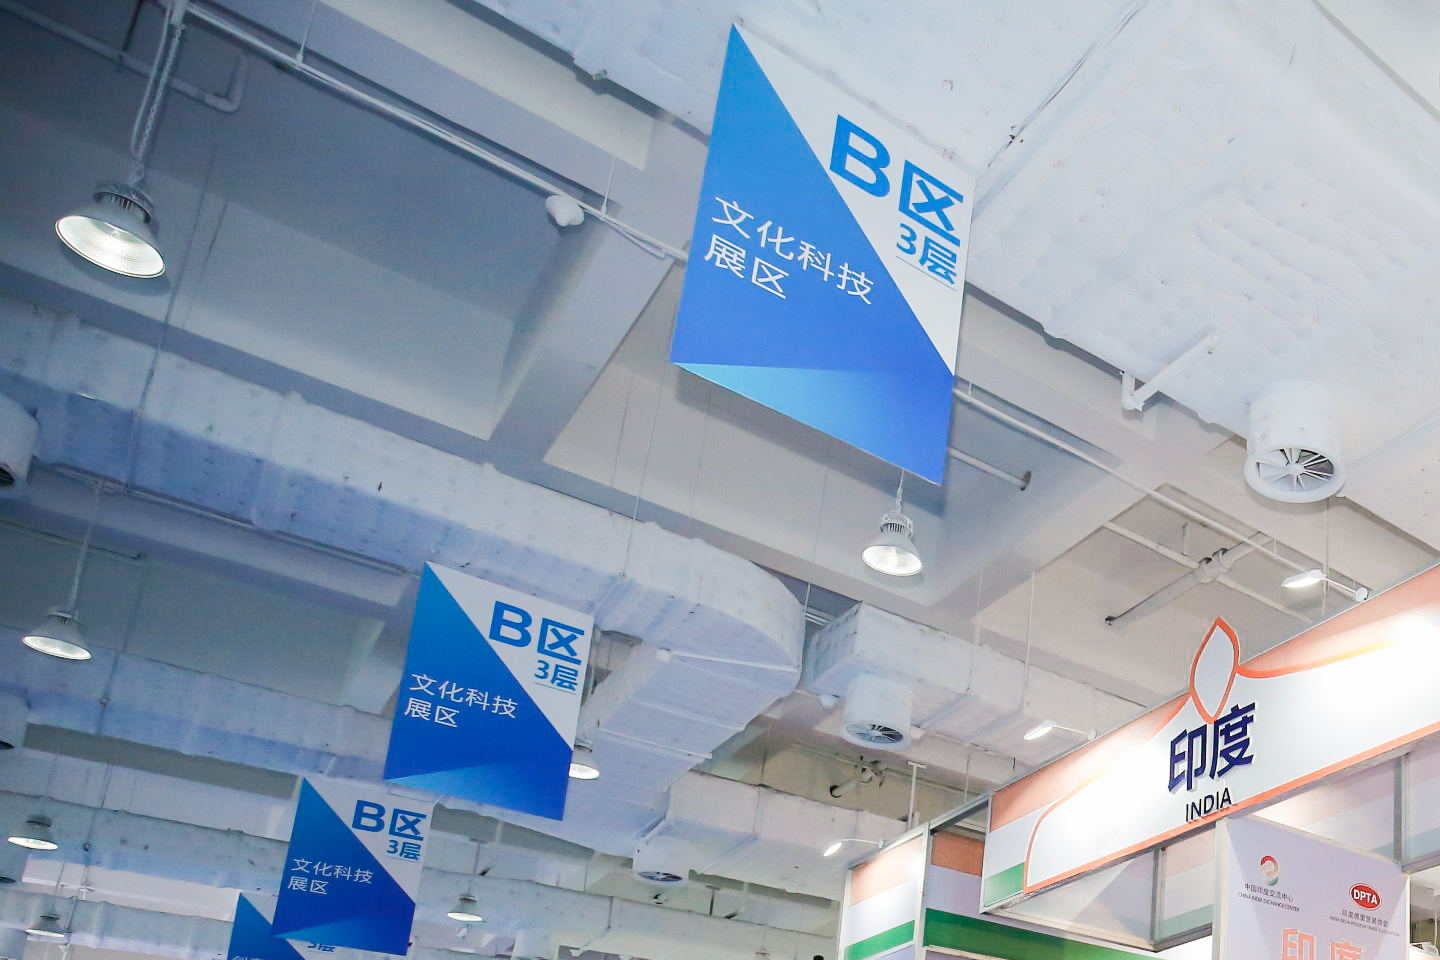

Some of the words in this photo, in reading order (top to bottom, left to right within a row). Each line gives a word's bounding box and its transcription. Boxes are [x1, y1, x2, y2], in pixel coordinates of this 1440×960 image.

[830, 114, 964, 247] B区
[704, 233, 789, 299] 展区
[712, 196, 875, 304] 文化科技
[896, 222, 958, 286] 3层
[489, 600, 585, 665] B区
[409, 673, 518, 718] 文化科技
[534, 659, 579, 691] 3层
[404, 697, 460, 728] 展区
[1168, 702, 1256, 793] 印度
[352, 799, 427, 841] B区
[1185, 787, 1232, 822] INDIA
[386, 839, 421, 860] 3层
[287, 876, 329, 895] 展区
[291, 858, 374, 884] 文化科技
[1353, 888, 1378, 905] DPTA
